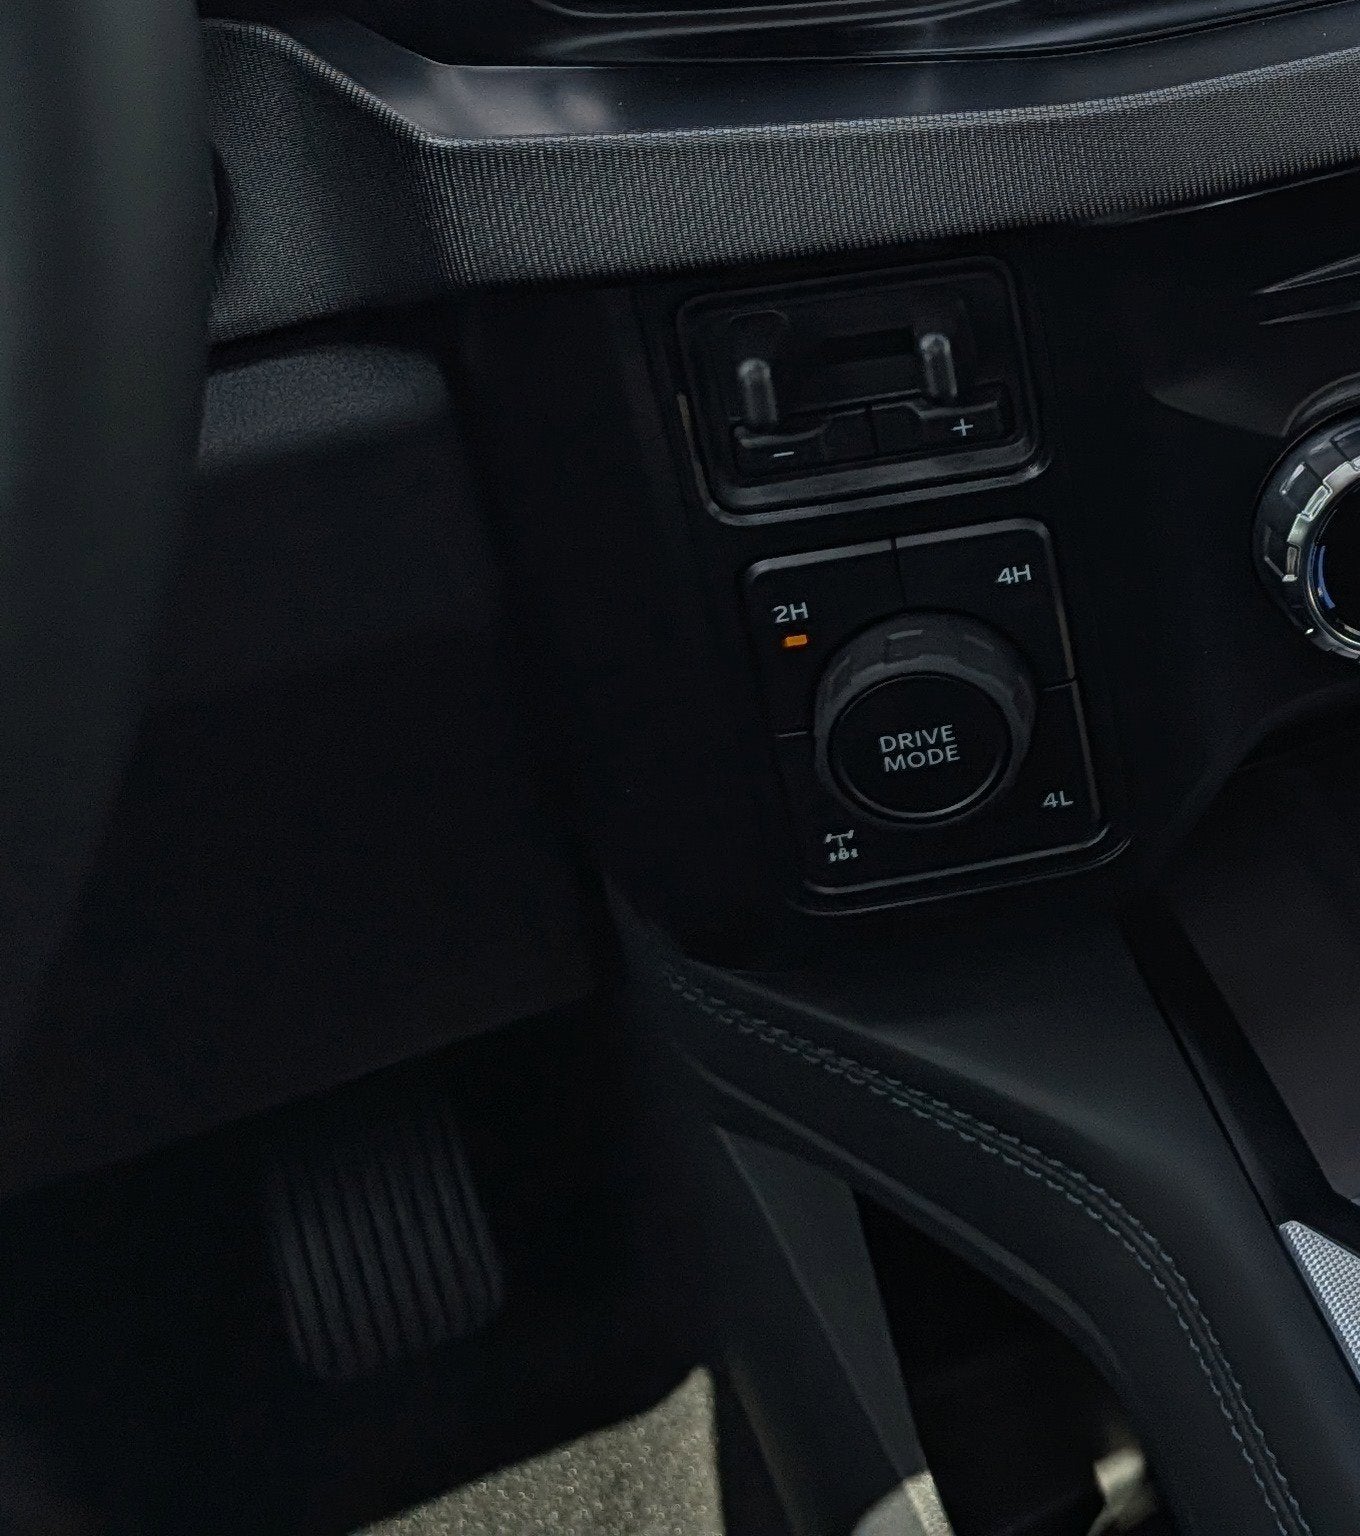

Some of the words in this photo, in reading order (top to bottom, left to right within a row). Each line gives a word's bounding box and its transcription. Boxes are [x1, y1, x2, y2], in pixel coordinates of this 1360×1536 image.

[998, 565, 1032, 587] 4H
[773, 602, 809, 624] 2H
[879, 725, 956, 753] DRIVE
[884, 743, 961, 772] MODE
[1043, 791, 1074, 809] 4L
